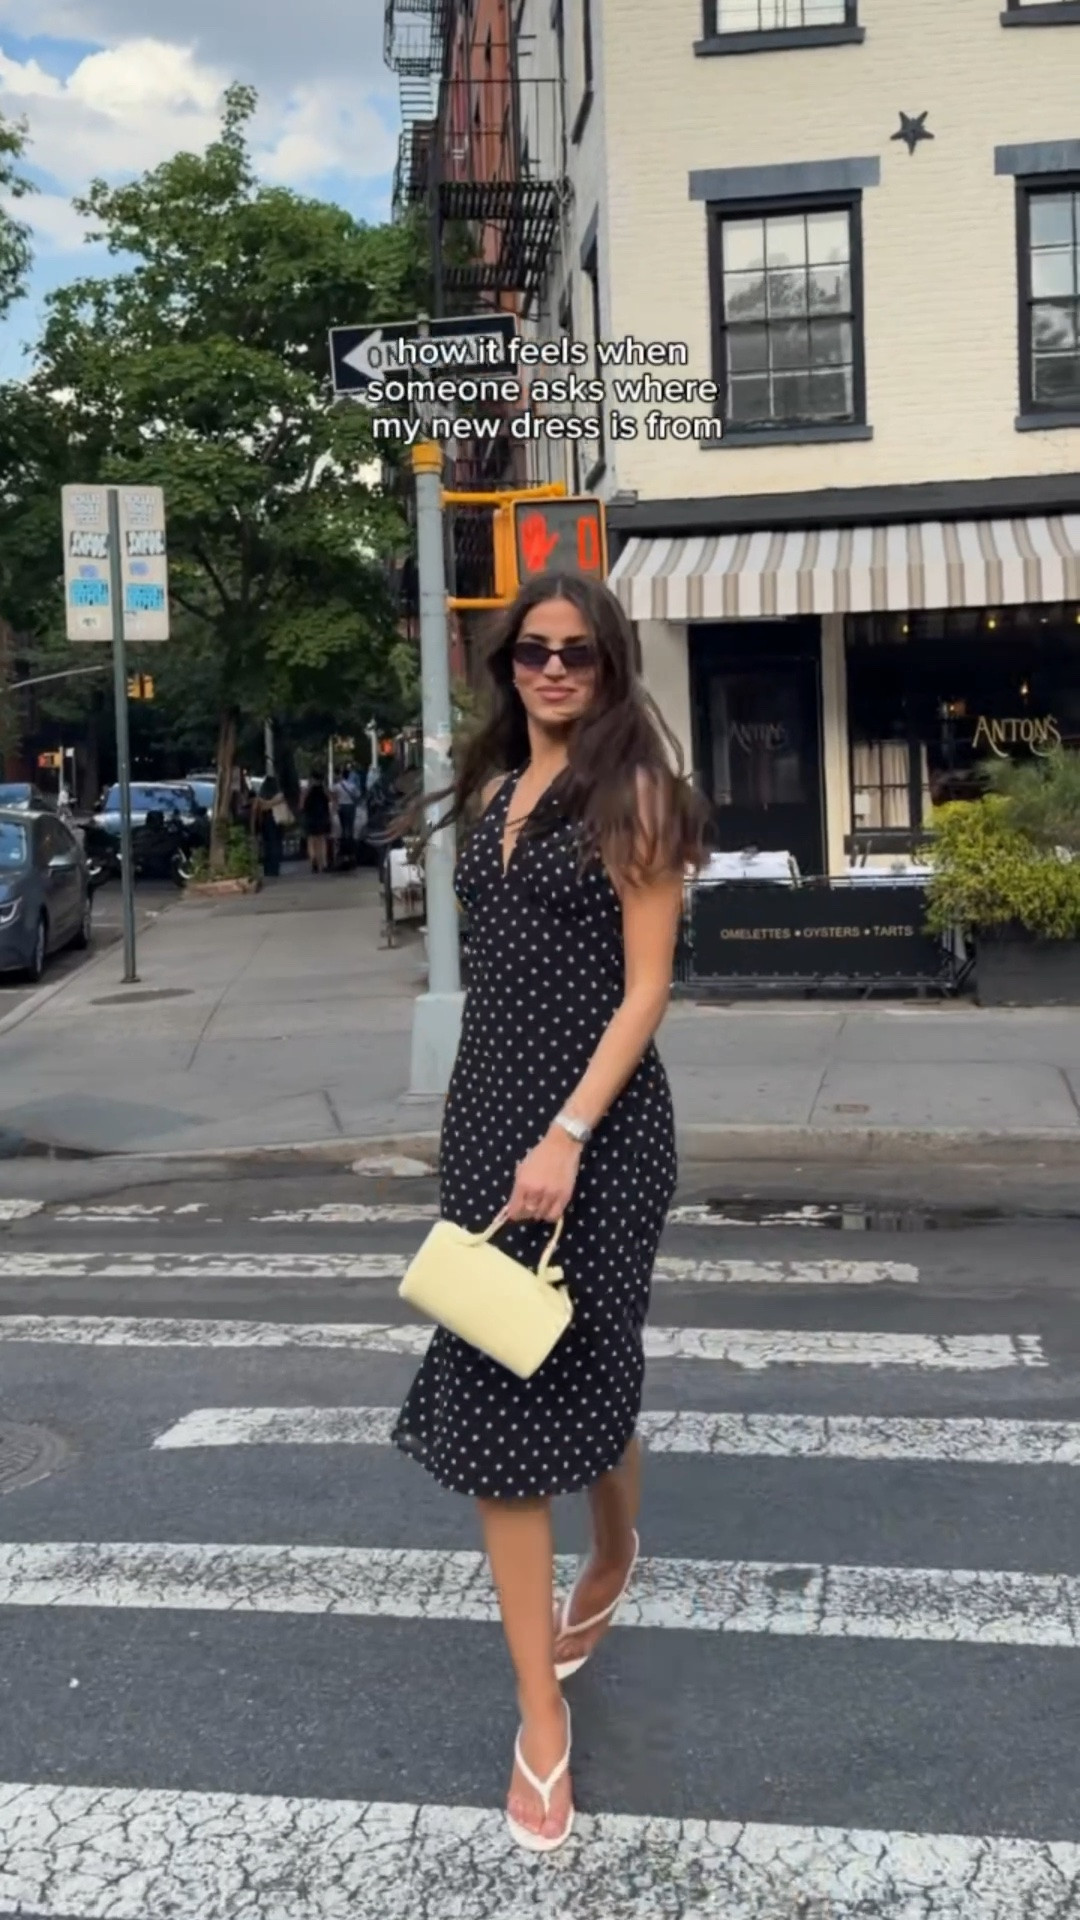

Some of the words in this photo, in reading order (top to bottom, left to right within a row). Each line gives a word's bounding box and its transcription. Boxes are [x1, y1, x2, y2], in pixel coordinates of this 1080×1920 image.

[577, 516, 600, 571] 0
[720, 927, 792, 940] OMELETTES
[803, 926, 860, 938] OYSTERS
[873, 925, 914, 937] TARTS
